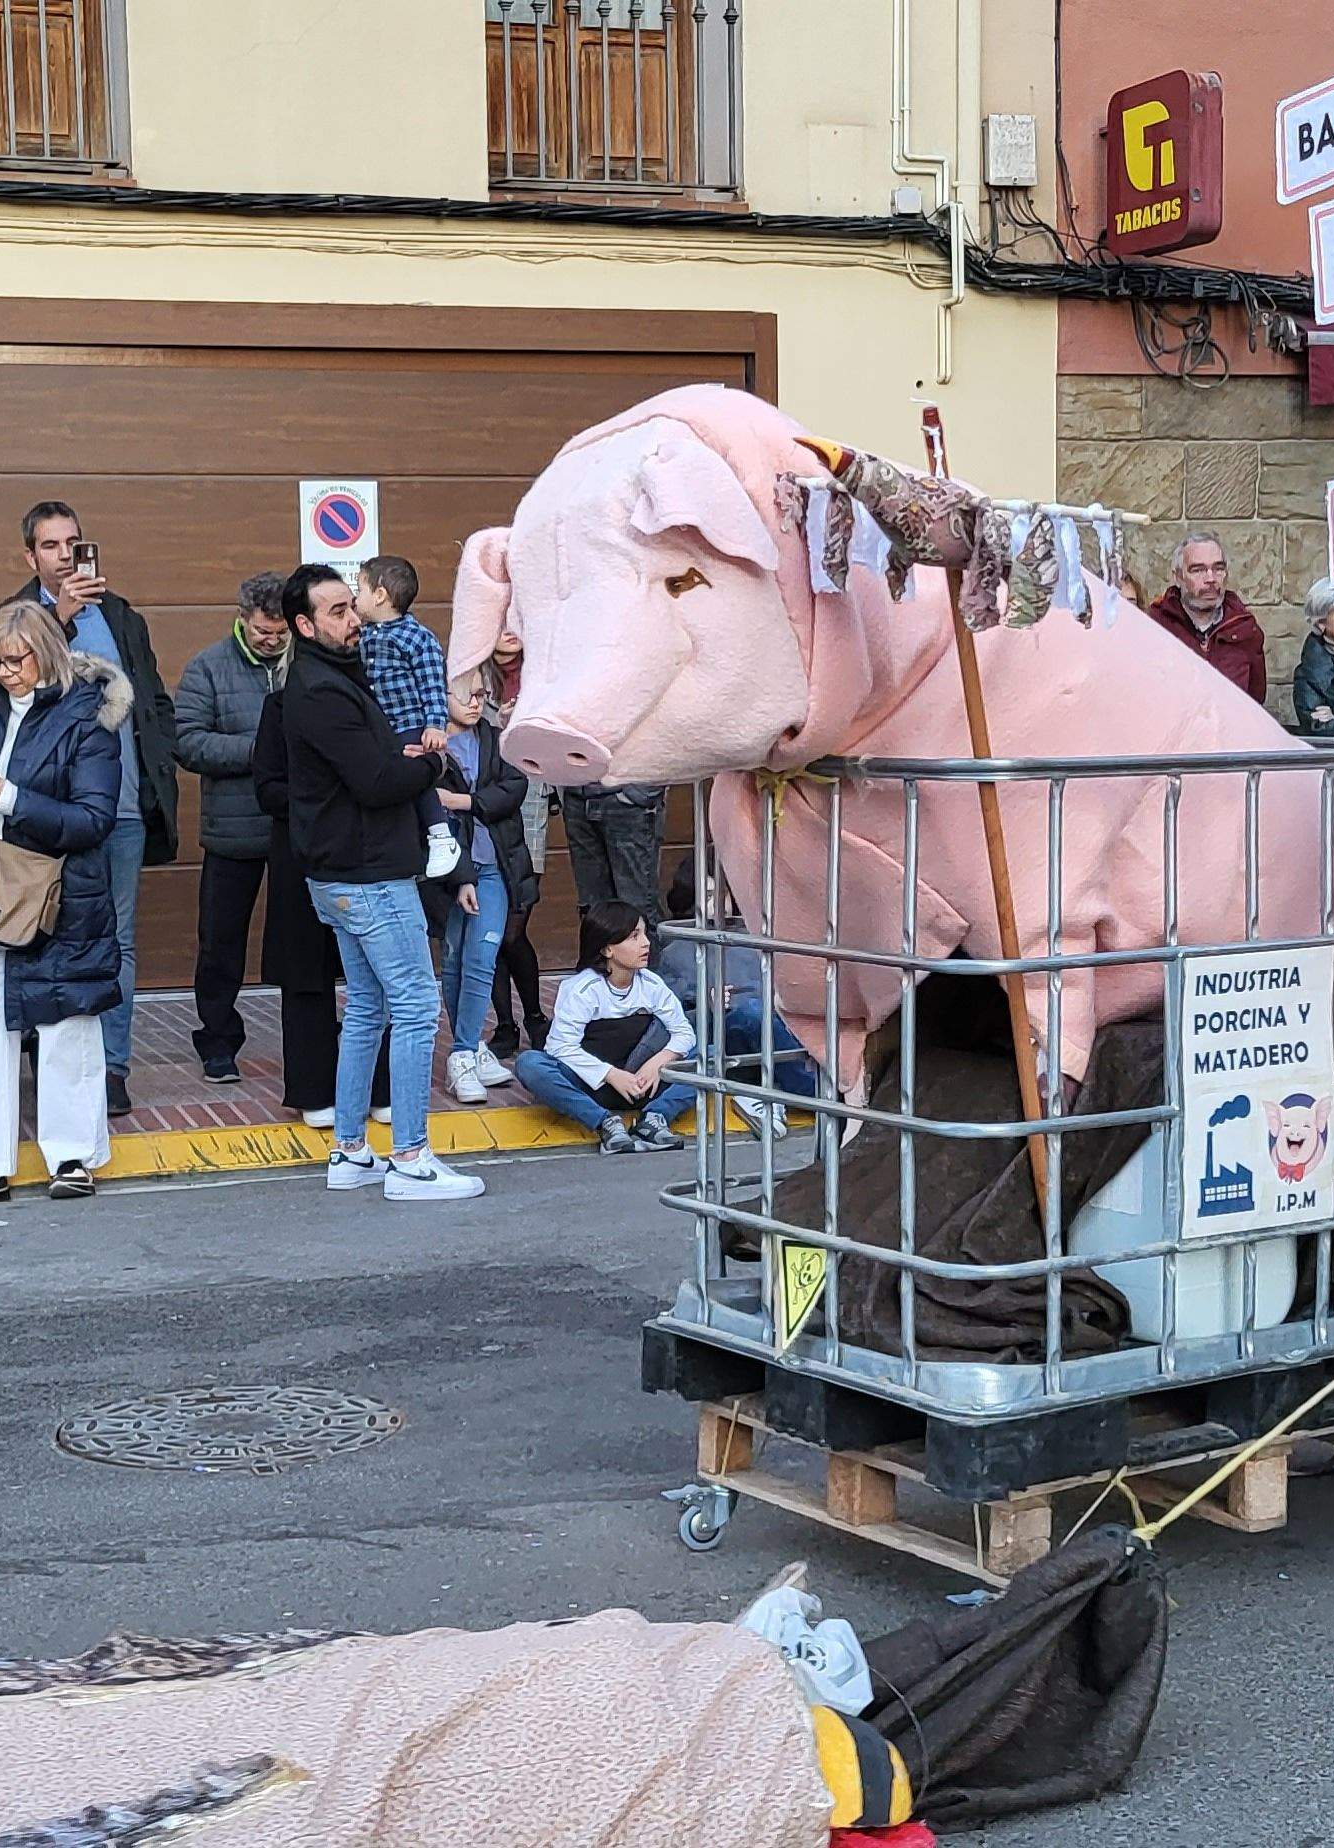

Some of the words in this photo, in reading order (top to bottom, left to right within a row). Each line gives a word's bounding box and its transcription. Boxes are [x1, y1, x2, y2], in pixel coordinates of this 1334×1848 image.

[1114, 196, 1182, 236] TABACOS
[1194, 965, 1302, 997] INDUSTRIA
[1193, 1005, 1288, 1036] PORCINA
[1297, 1002, 1312, 1026] Y
[1193, 1040, 1310, 1075] MATADERO
